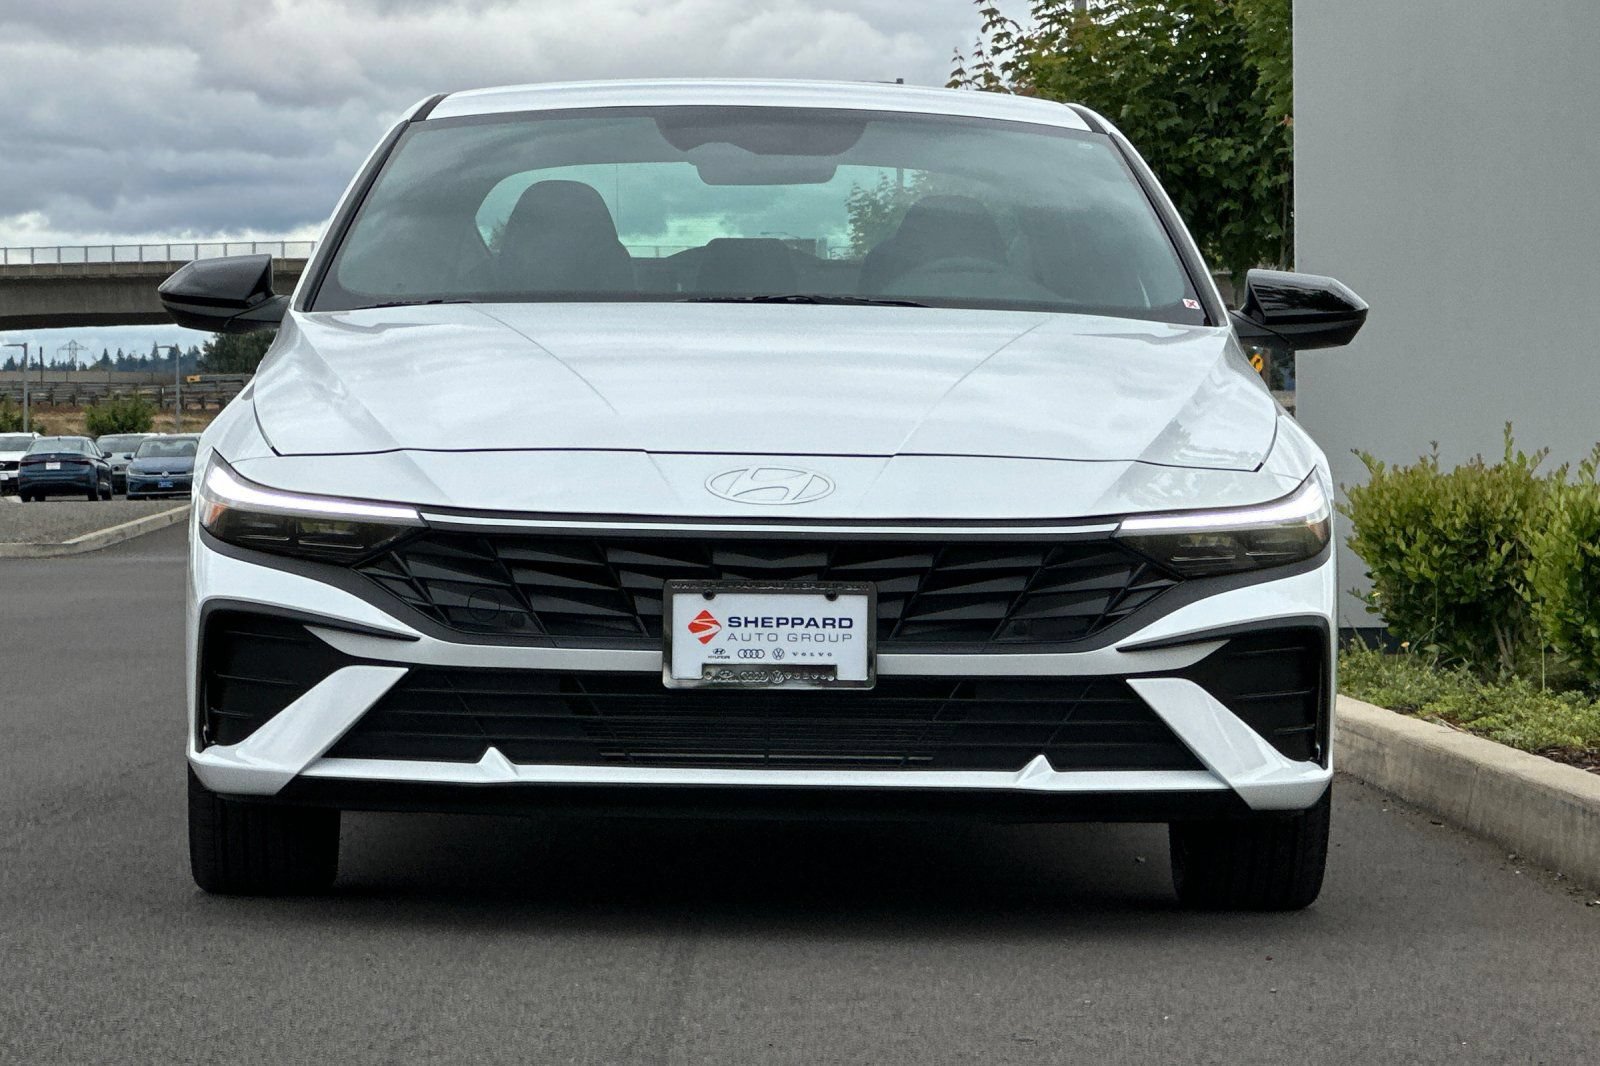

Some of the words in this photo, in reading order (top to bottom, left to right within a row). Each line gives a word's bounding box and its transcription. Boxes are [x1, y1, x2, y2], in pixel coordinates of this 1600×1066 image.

[728, 616, 853, 629] SHEPPARD
[727, 633, 778, 642] AUTO
[787, 633, 853, 643] GROUP
